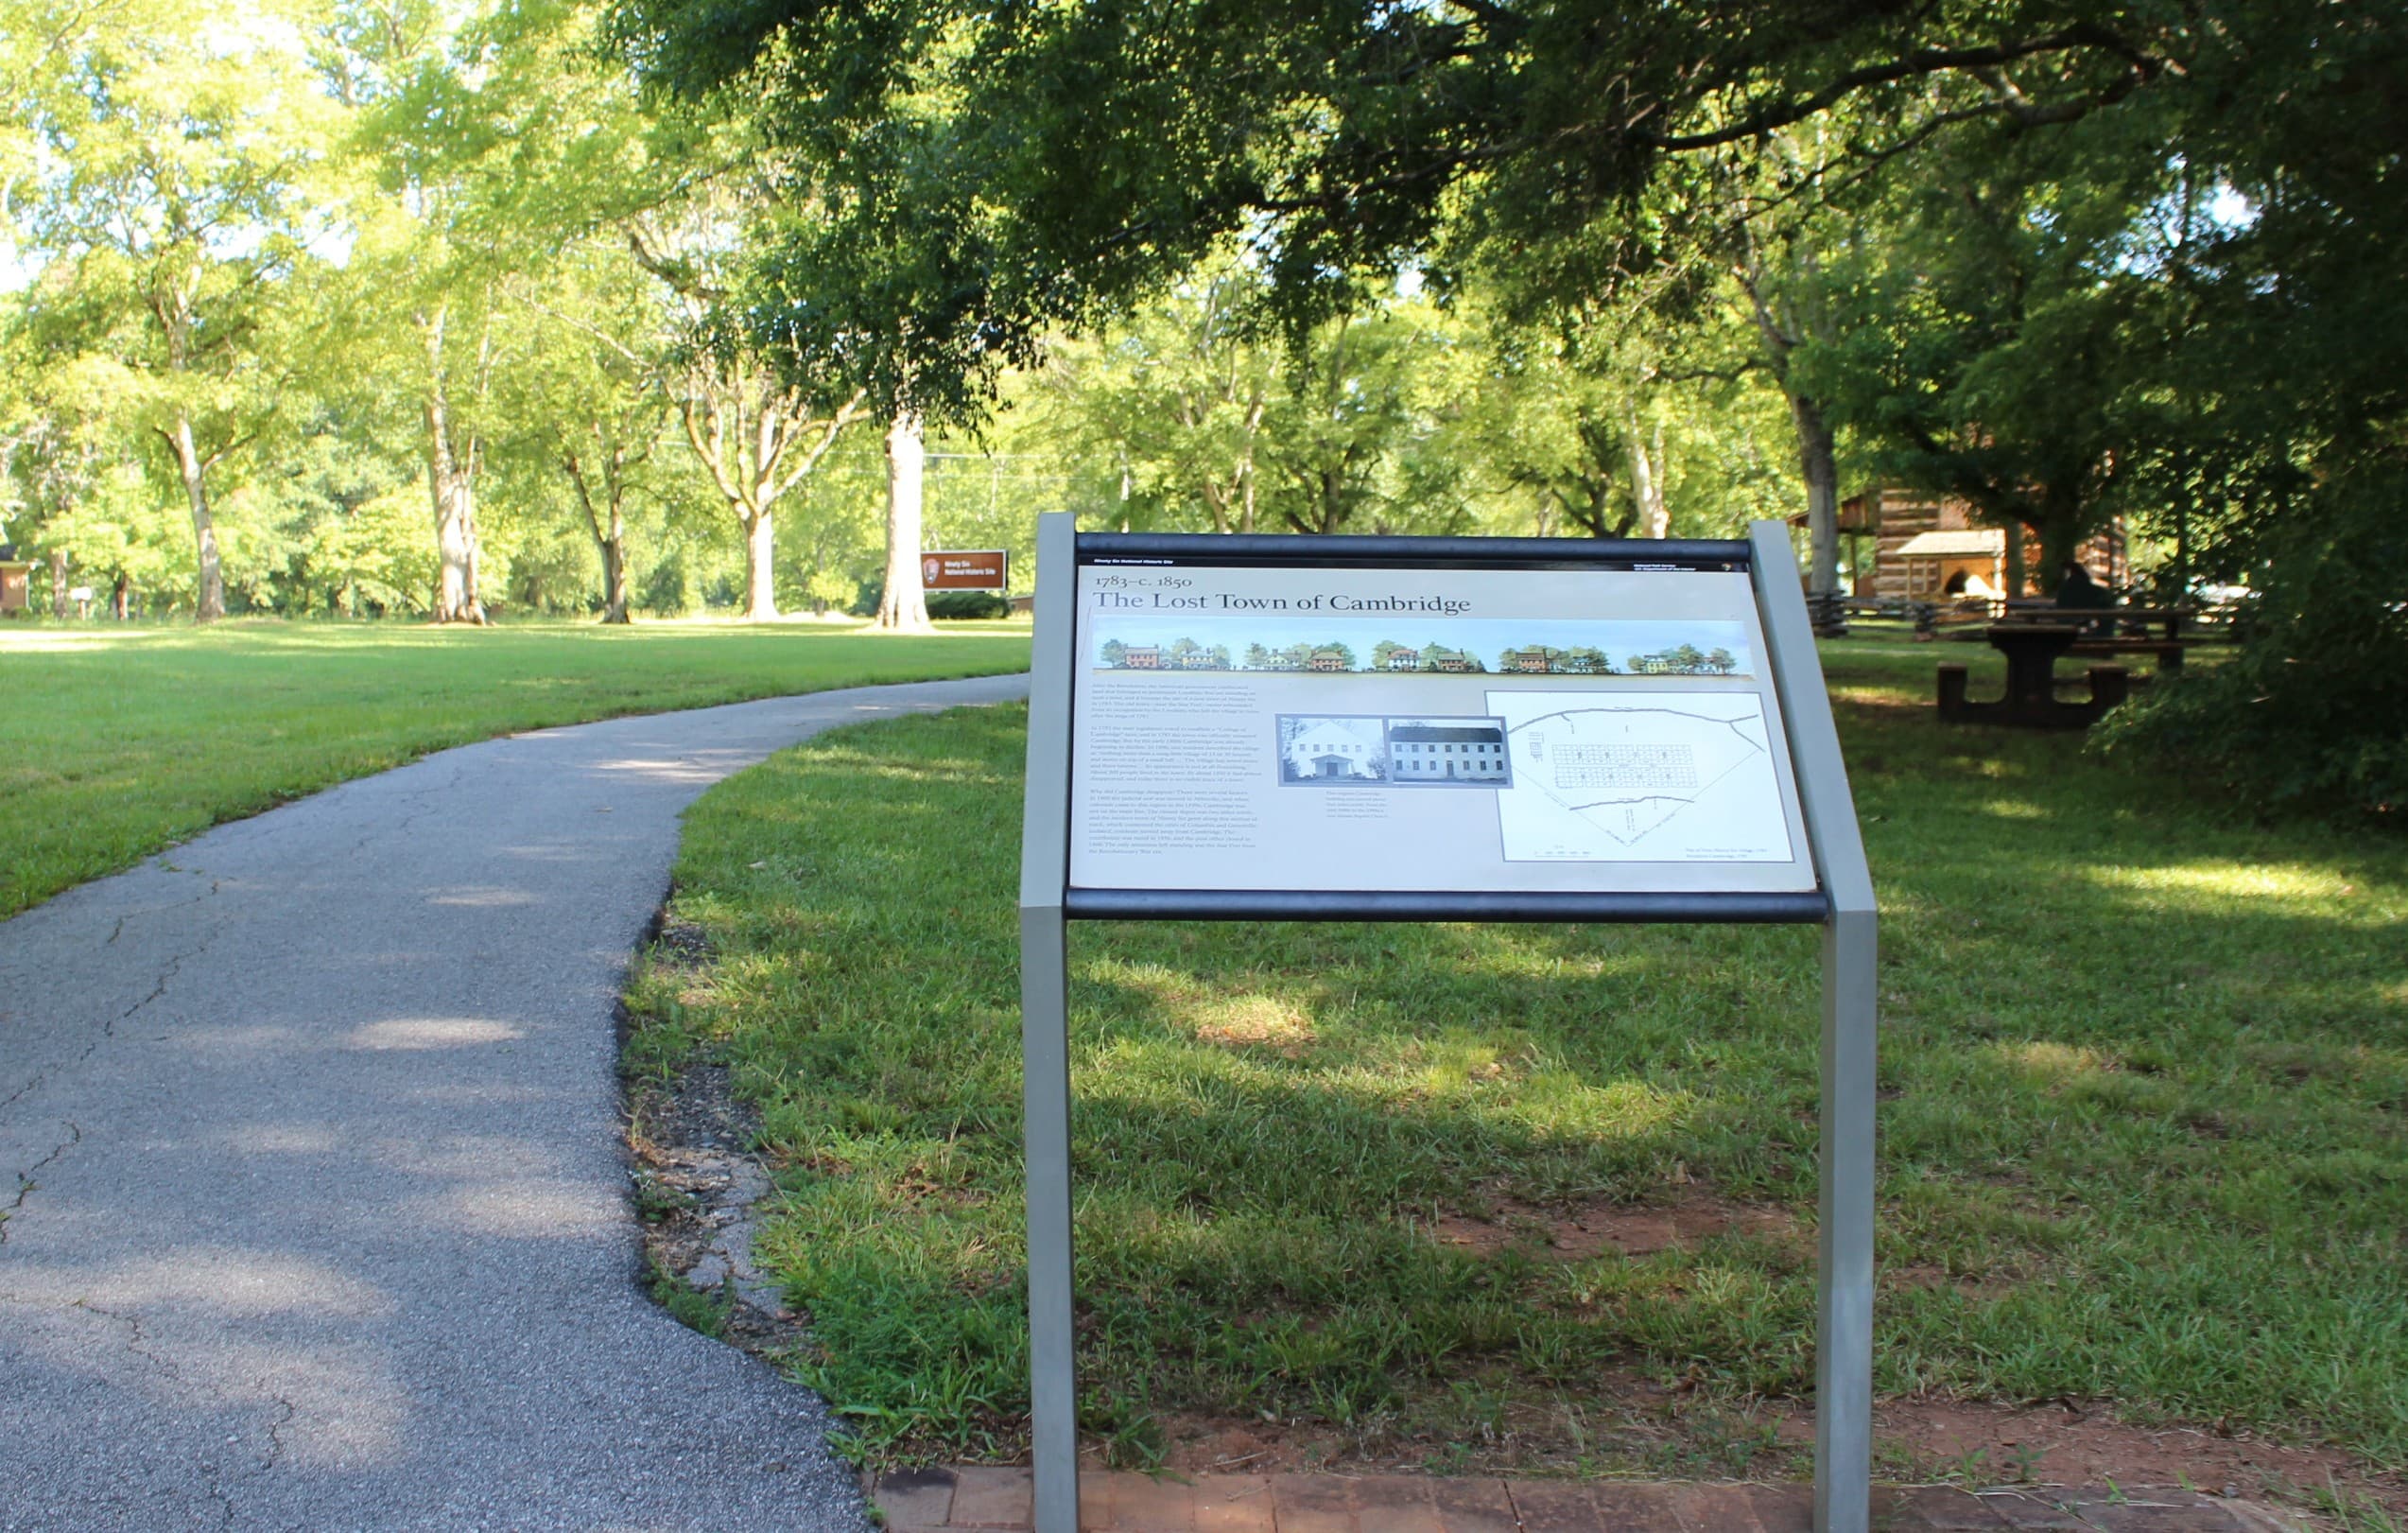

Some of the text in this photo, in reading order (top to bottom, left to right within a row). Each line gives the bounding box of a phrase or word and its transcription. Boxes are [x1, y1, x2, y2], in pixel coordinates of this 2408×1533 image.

[1158, 576, 1193, 589] 1850
[1093, 592, 1471, 616] The Lost Town of Cambridge
